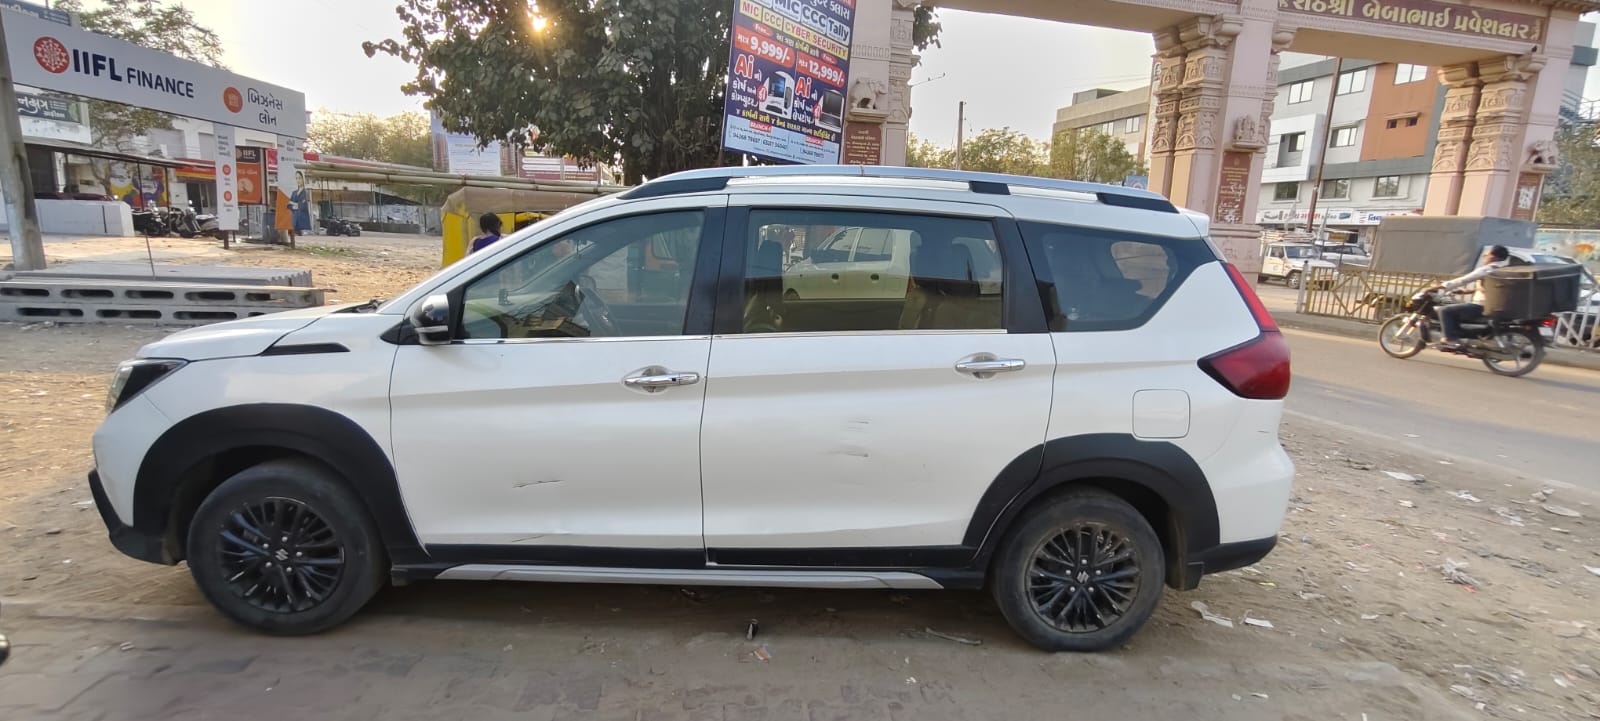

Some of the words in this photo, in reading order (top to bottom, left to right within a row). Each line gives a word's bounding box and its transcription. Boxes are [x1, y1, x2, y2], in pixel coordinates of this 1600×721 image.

[743, 3, 759, 17] MIC
[765, 12, 781, 27] CCC
[803, 7, 826, 27] CCC
[1362, 0, 1452, 28] બેબાભાઈ
[786, 21, 812, 41] CYBER
[814, 35, 848, 57] SECURITY
[829, 20, 850, 41] Tally
[751, 37, 790, 63] 9,999/-
[73, 48, 122, 82] IIFL
[127, 67, 195, 98] FINANCE
[735, 55, 755, 79] Ai
[809, 61, 845, 85] 12,999/-
[248, 87, 283, 110] બિઝનેસ
[795, 77, 812, 99] Ai
[259, 109, 277, 126] લોન
